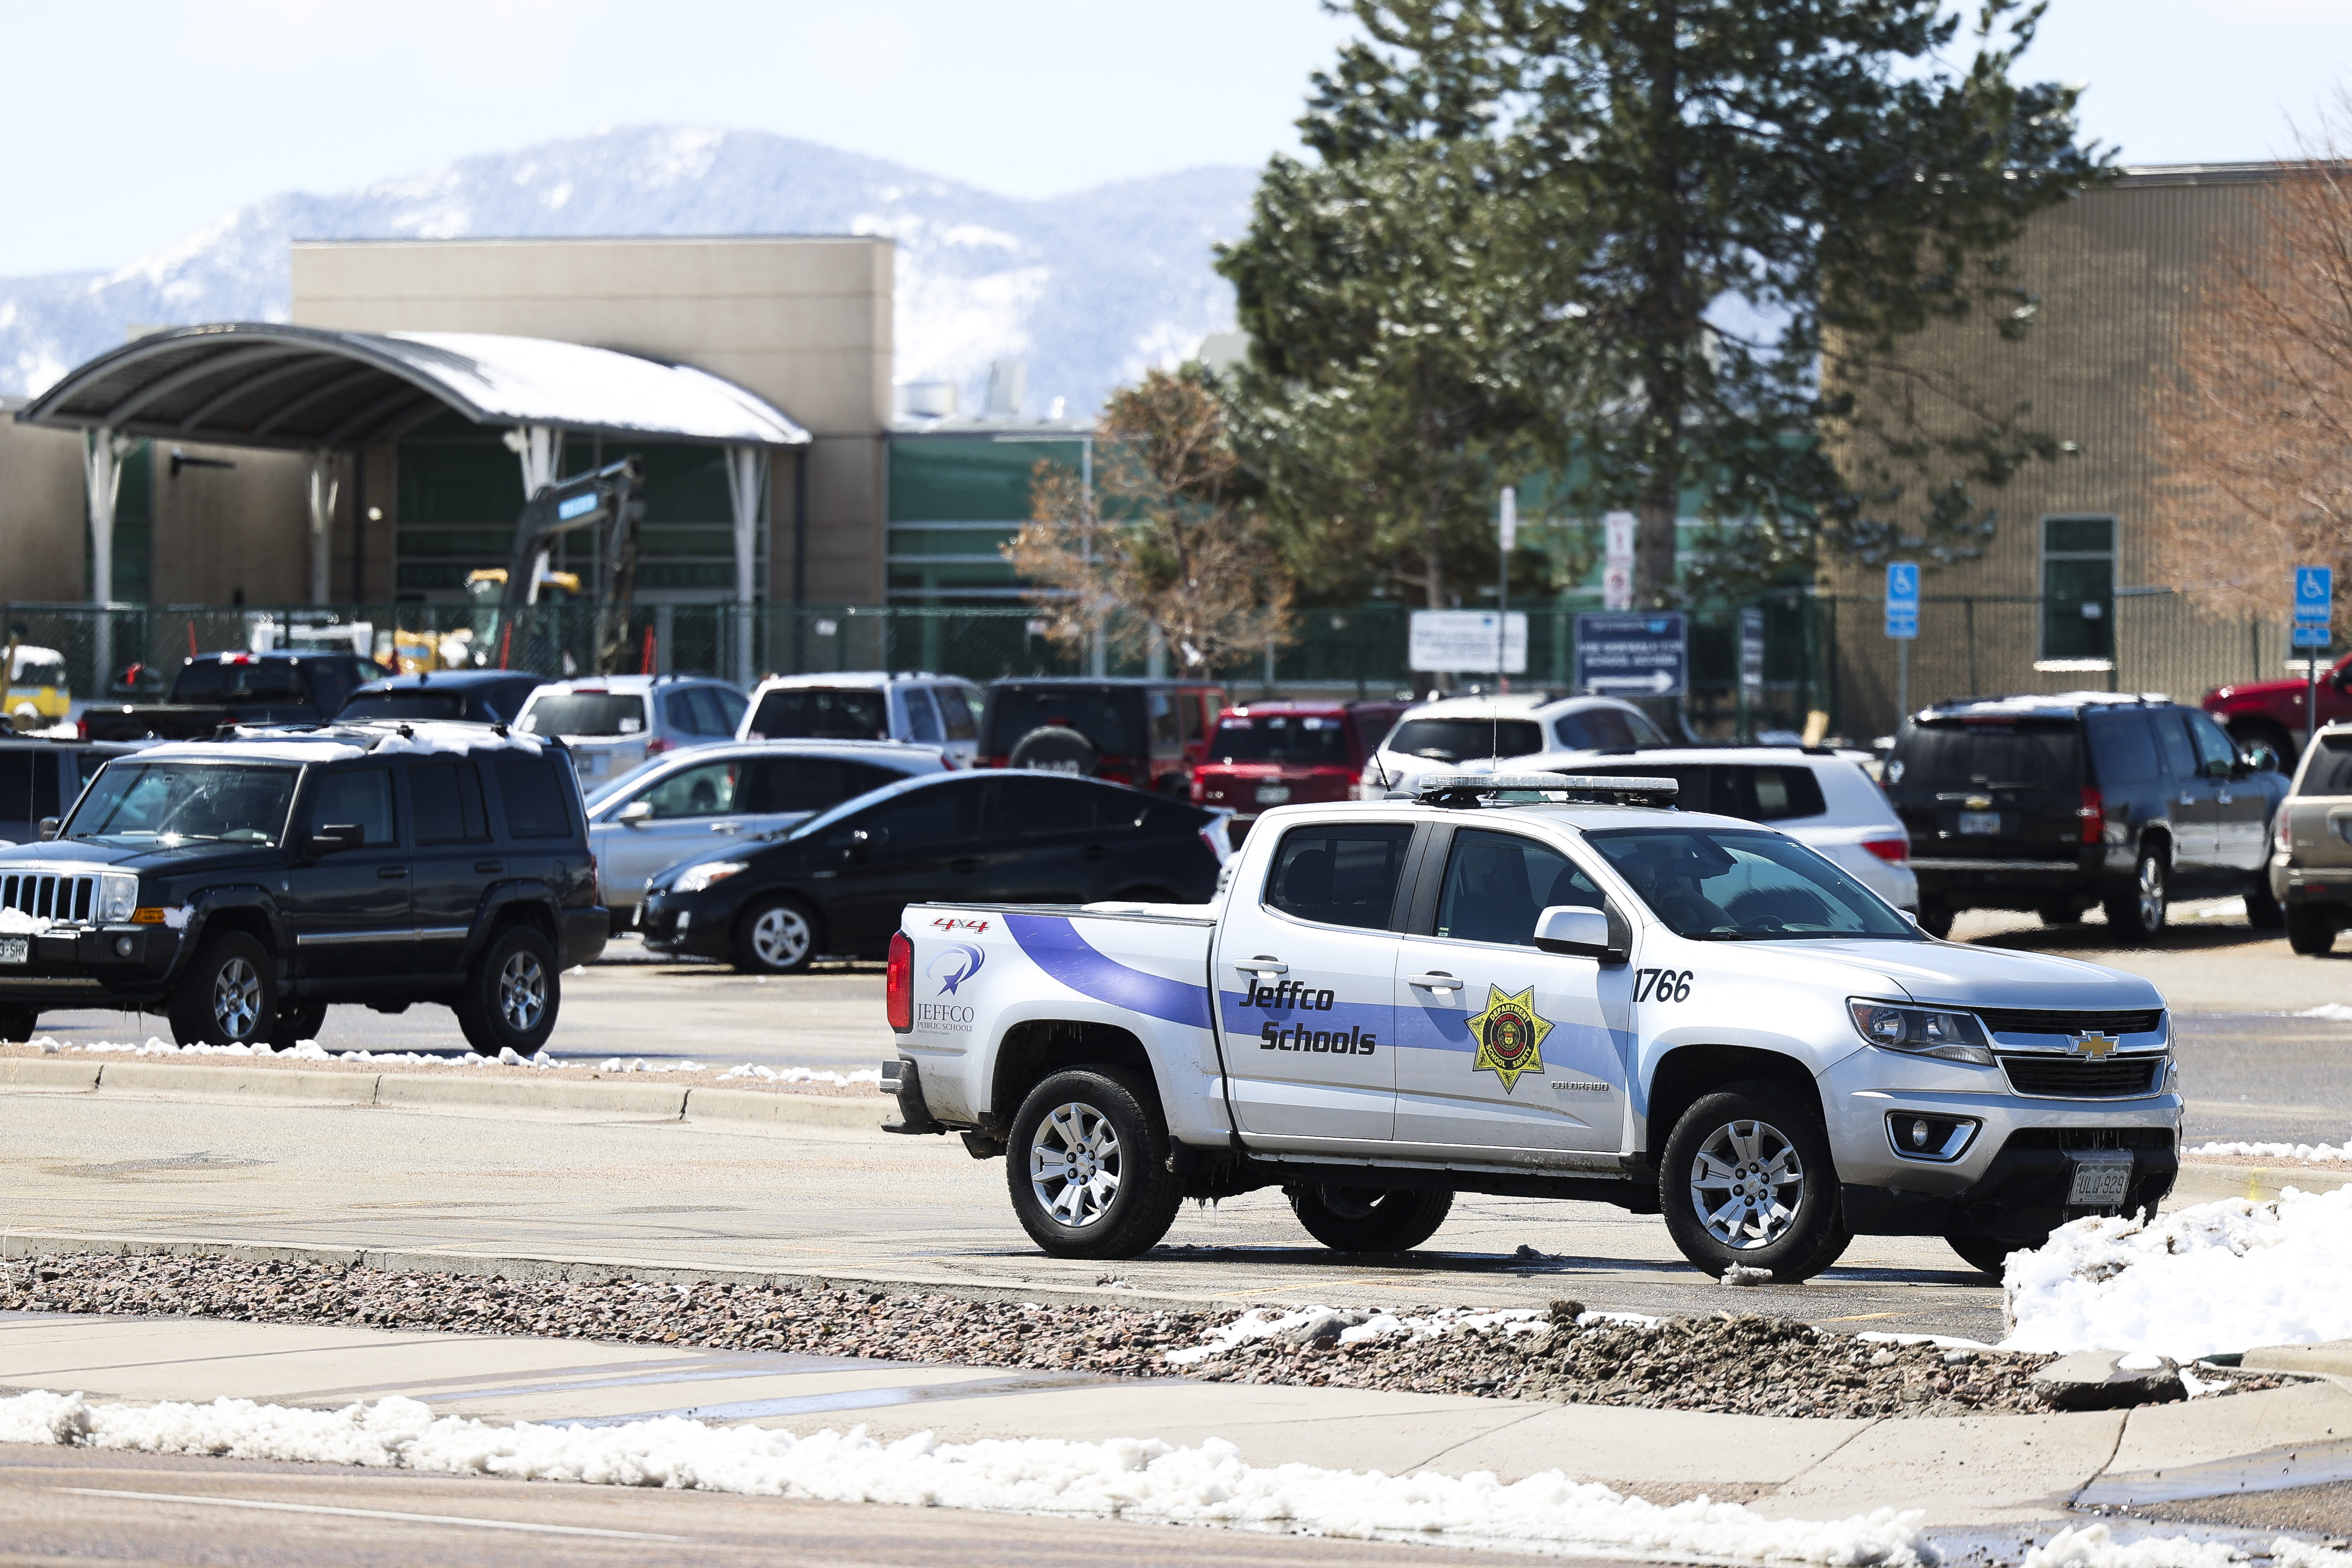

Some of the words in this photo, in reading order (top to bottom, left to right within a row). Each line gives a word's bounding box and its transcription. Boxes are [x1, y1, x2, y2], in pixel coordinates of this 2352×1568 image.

[1239, 978, 1335, 1011] Jeffco
[1632, 968, 1694, 1003] 1766
[917, 1003, 974, 1023] JEFFCO
[1489, 1004, 1530, 1023] DEPARTMENT
[1496, 1014, 1514, 1026] STATE
[1515, 1018, 1523, 1026] OF
[942, 1023, 973, 1032] SCHOOLS
[1260, 1021, 1376, 1055] Schools
[1486, 1044, 1506, 1068] SCHOOL
[1512, 1046, 1531, 1067] SAFETY
[1493, 1041, 1524, 1056] COLORADO
[1551, 1080, 1609, 1091] COLORADO
